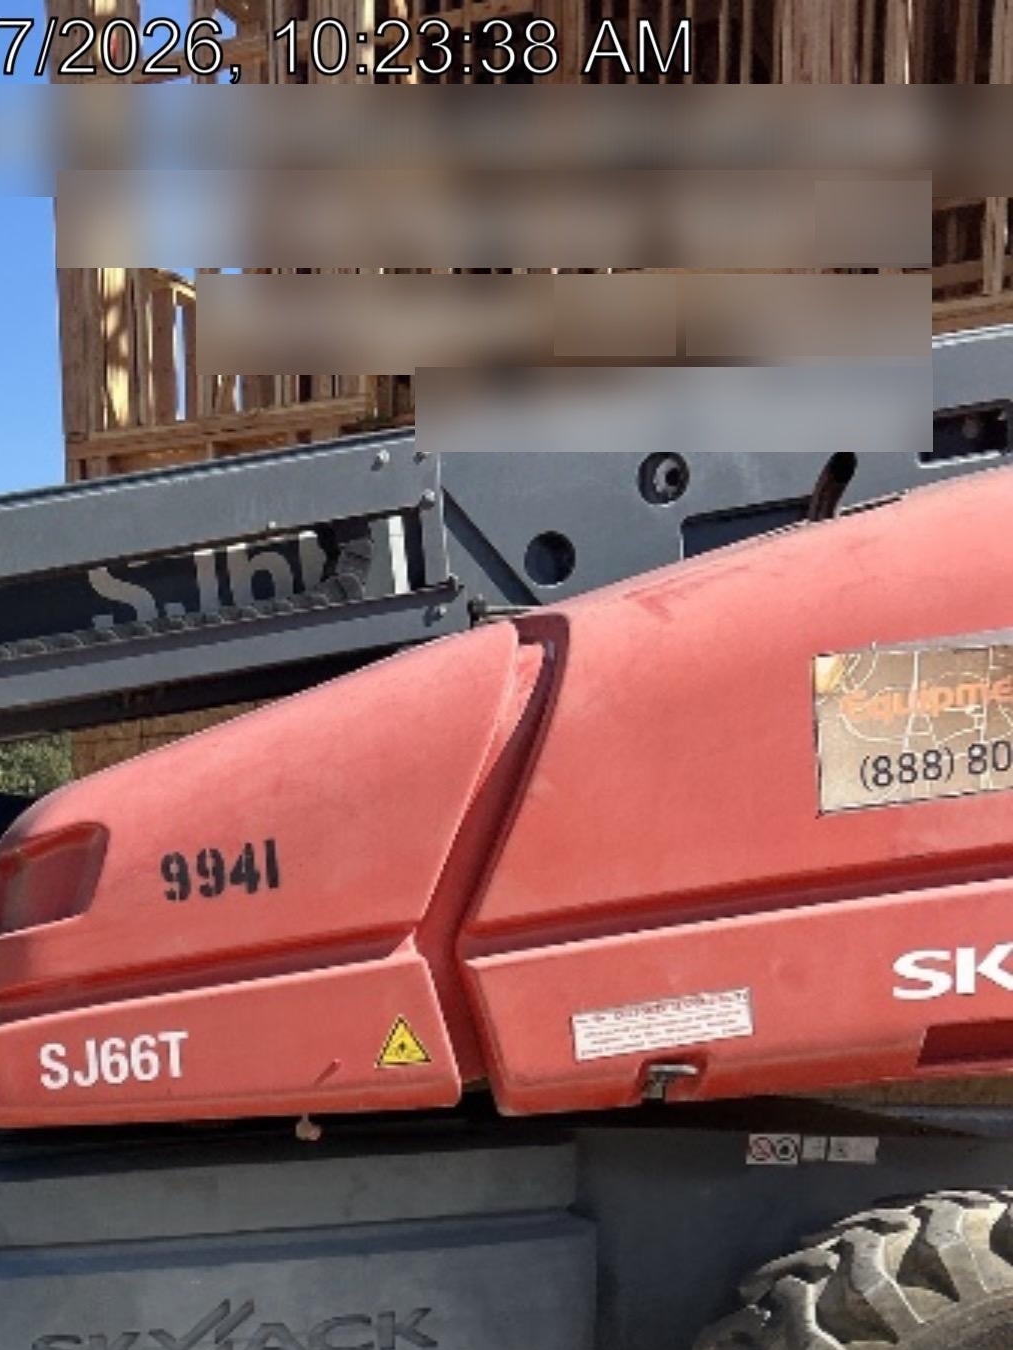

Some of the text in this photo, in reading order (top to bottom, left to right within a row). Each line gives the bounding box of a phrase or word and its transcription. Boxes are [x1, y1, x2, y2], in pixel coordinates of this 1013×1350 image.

[860, 740, 1012, 792] (888) 80
[161, 838, 280, 901] 9941
[892, 941, 1013, 1001] SK
[39, 1031, 189, 1090] SJ66T
